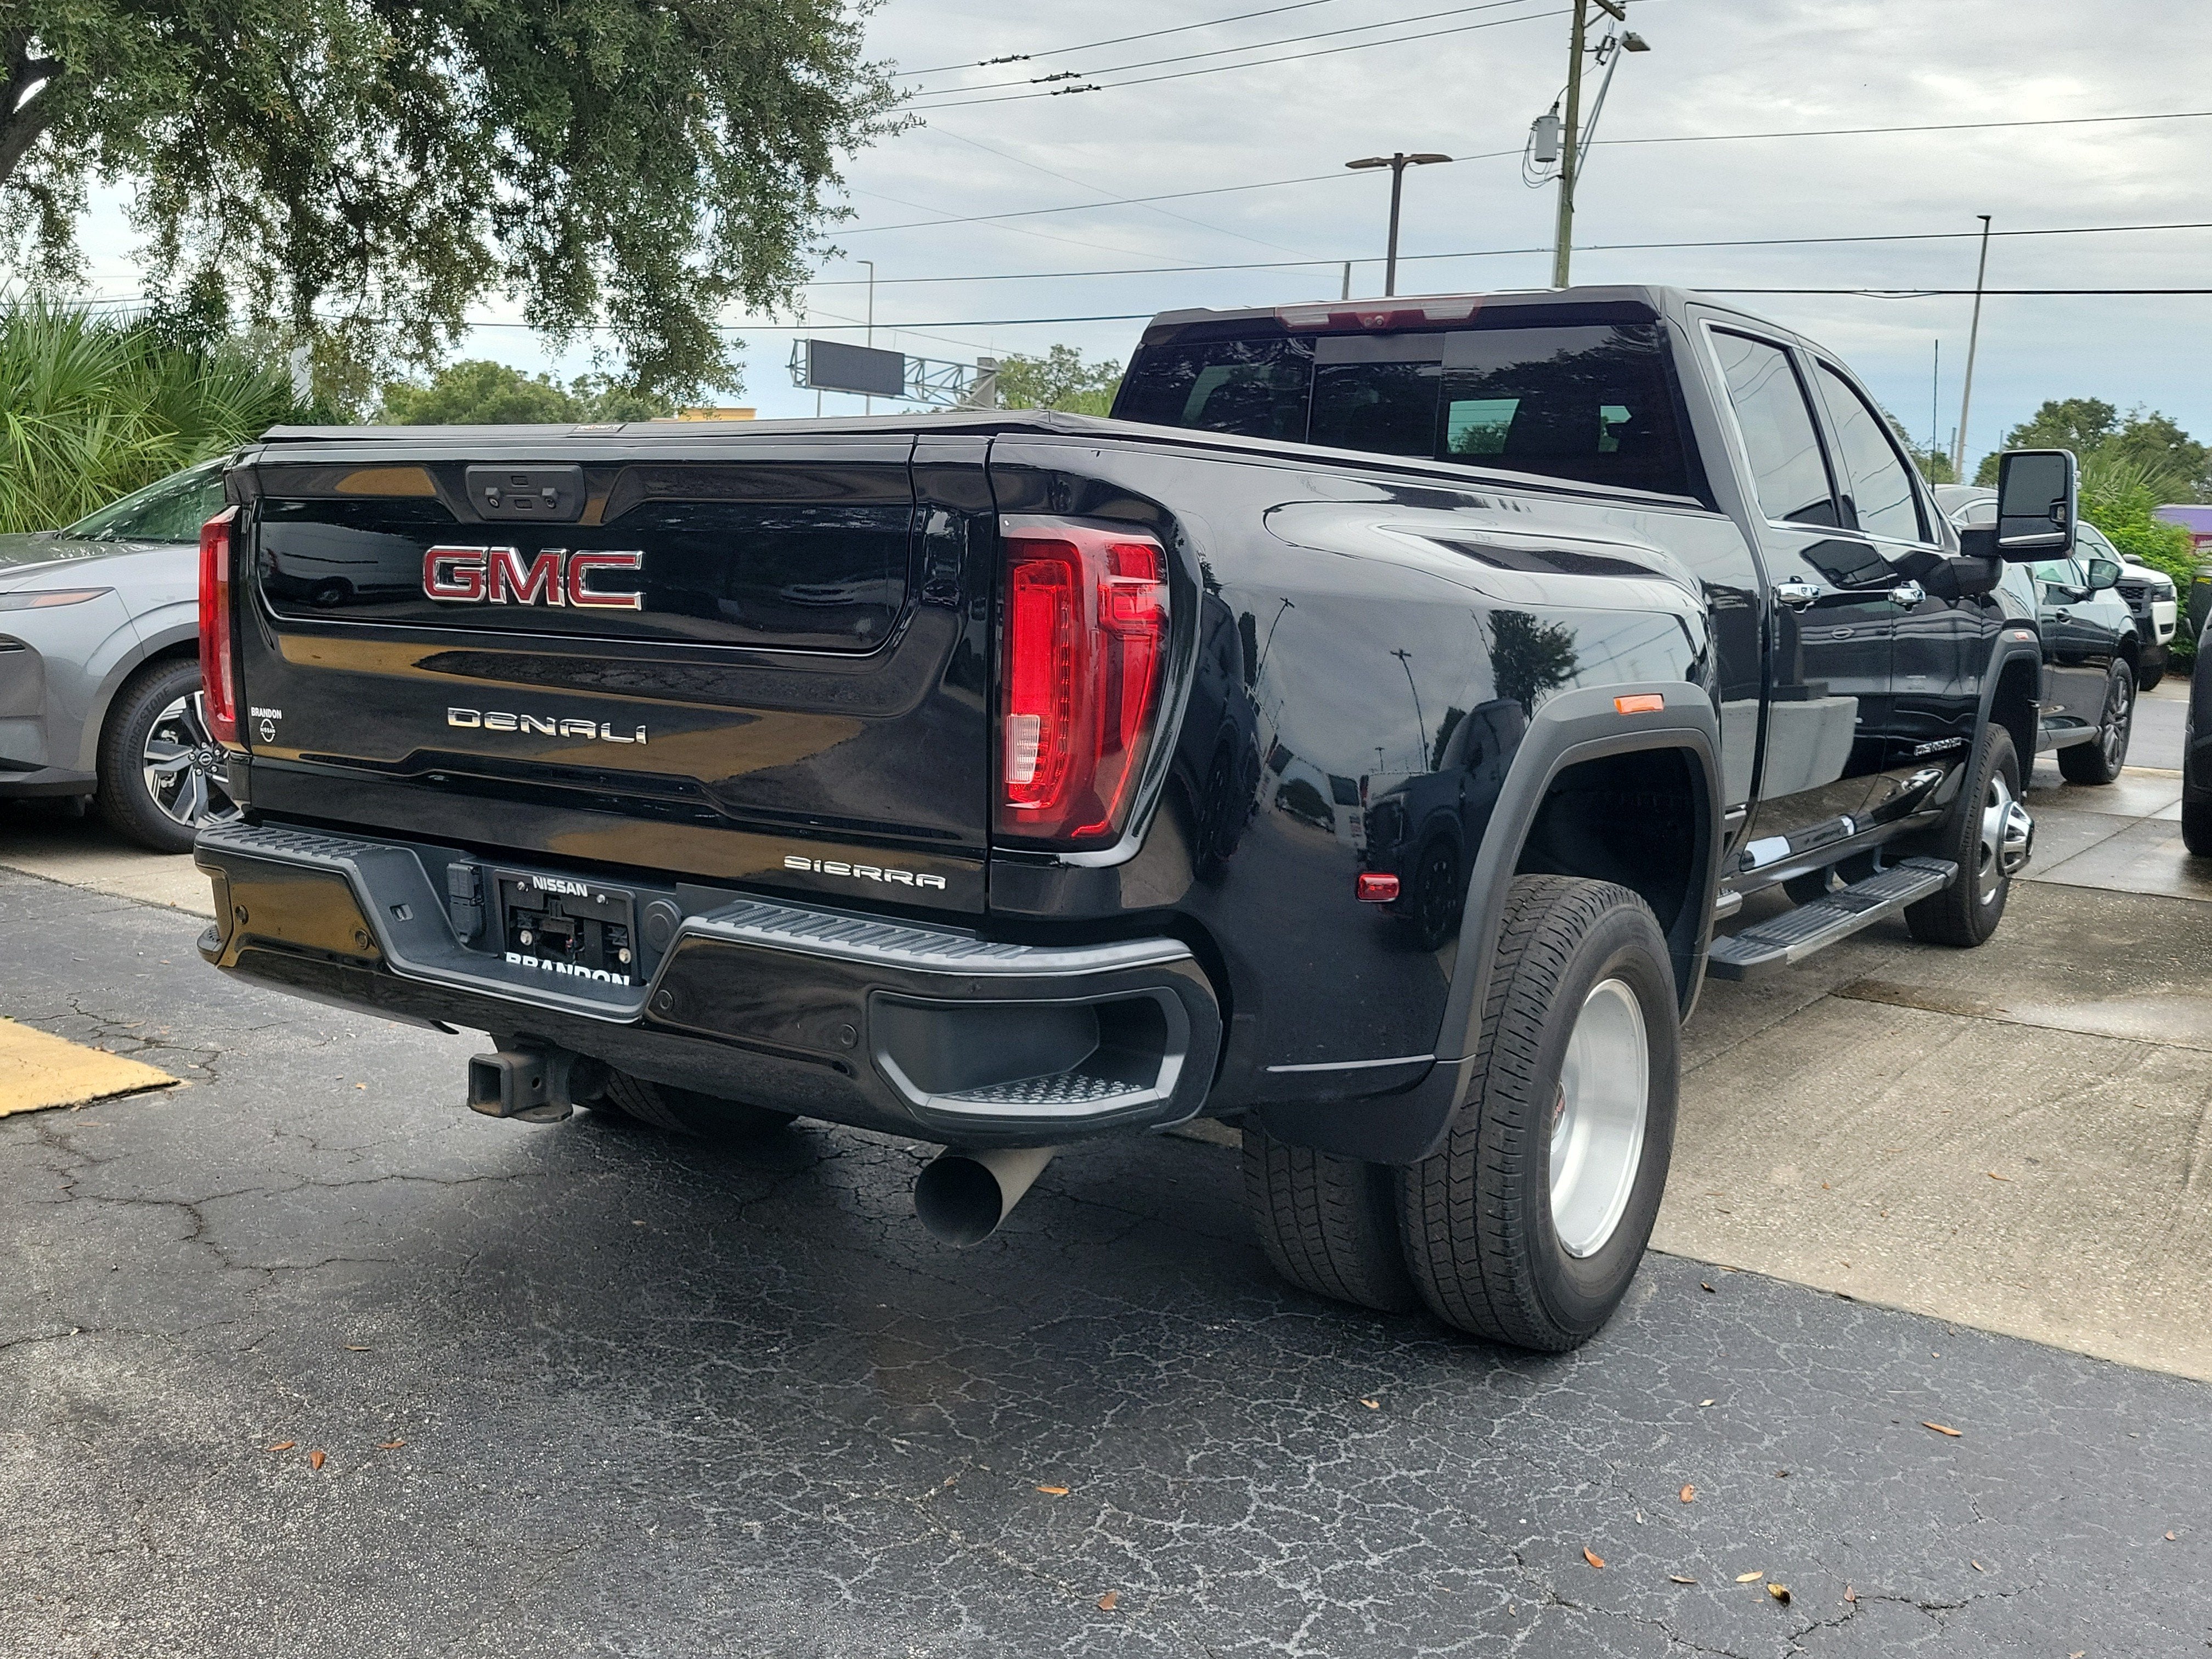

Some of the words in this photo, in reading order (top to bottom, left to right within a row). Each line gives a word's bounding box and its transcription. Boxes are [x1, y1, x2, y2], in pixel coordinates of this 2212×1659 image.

[424, 545, 645, 611] GMC
[251, 707, 282, 719] BRANDON
[447, 707, 648, 745] DENALI
[532, 876, 588, 897] NISSAN
[784, 855, 947, 890] SIERRA
